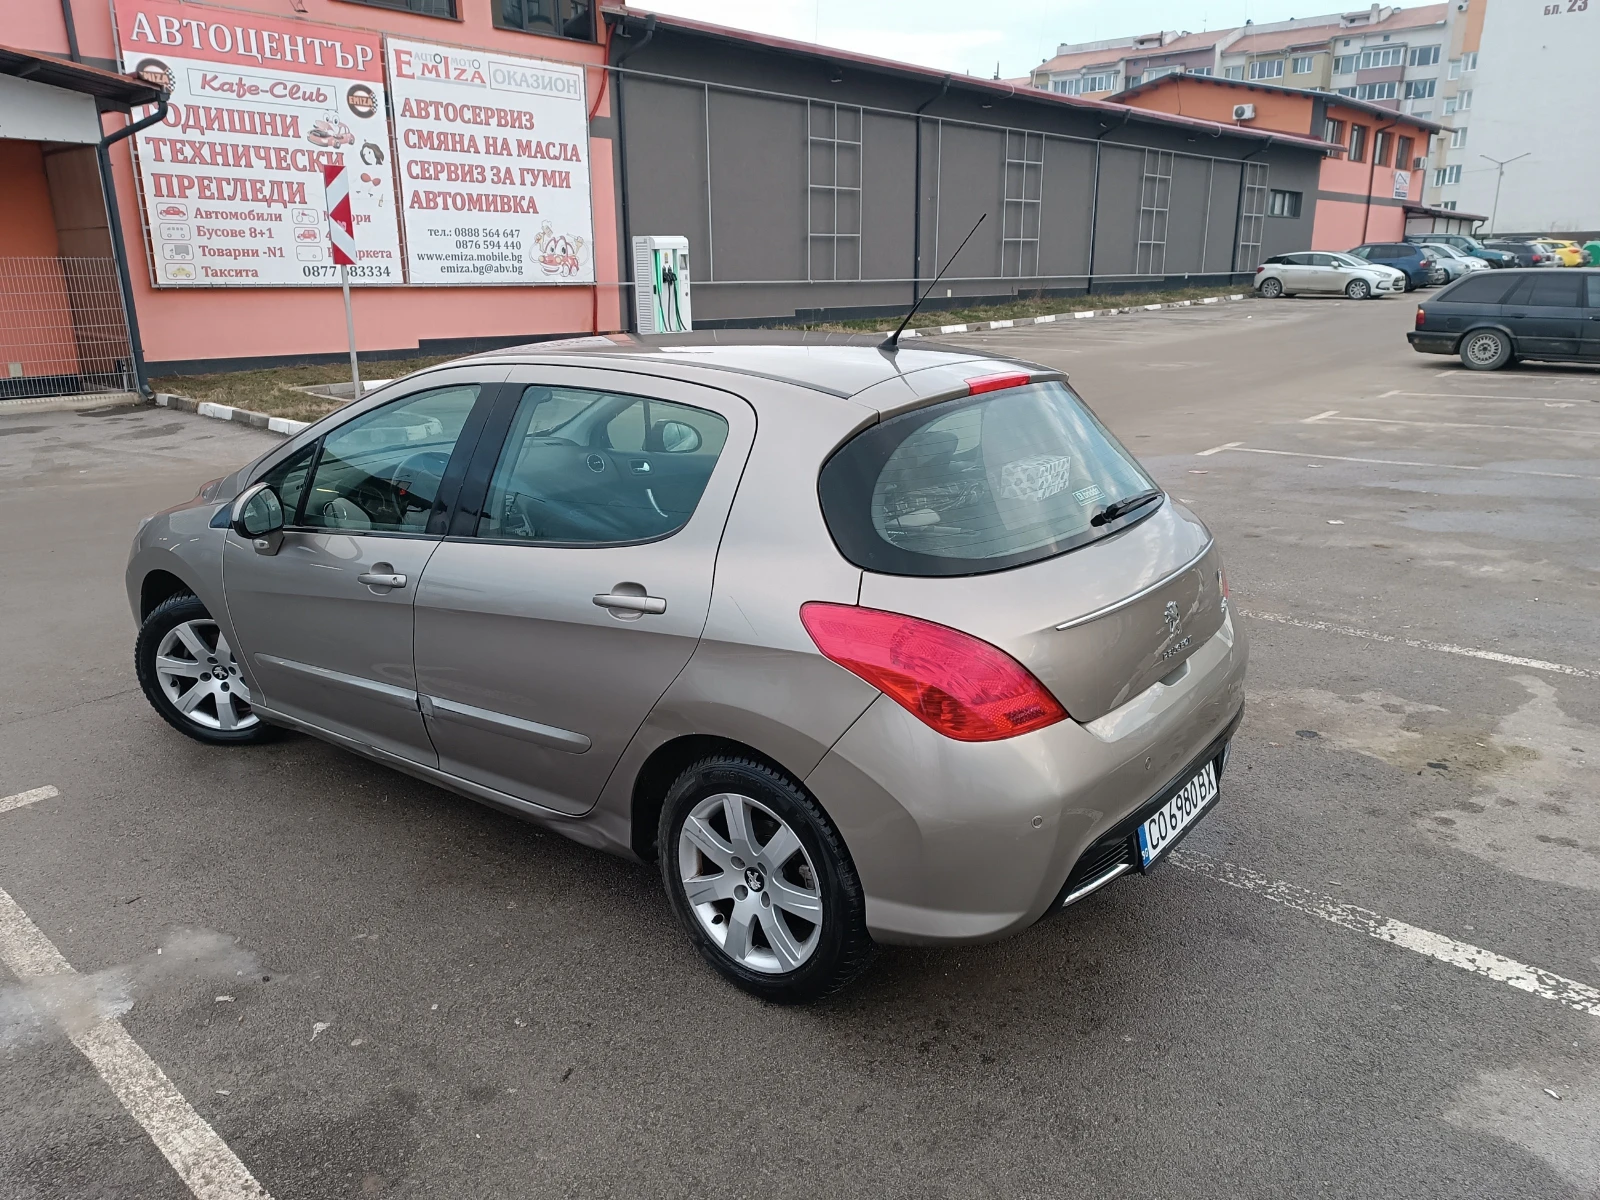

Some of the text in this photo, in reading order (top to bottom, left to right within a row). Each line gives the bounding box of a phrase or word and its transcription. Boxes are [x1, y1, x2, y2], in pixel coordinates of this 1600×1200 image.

[1566, 0, 1589, 13] 23
[130, 12, 374, 72] АВТОЦЕНТЪР
[140, 71, 170, 86] MIZA
[492, 68, 579, 95] ОКАЗИОН
[200, 73, 328, 104] Kafe-Club
[348, 95, 374, 108] EMIZA
[401, 97, 535, 131] АВТОСЕРВИЗ
[403, 128, 581, 162] СМЯНА НА МАСЛА
[406, 160, 571, 189] СЕРВИЗ ЗА ГУМИ
[151, 173, 307, 208] ПРЕГЛЕДИ
[409, 190, 539, 214] АВТОМИВКА
[194, 207, 283, 222] Автомобили
[196, 225, 275, 240] Бусове 8+1
[454, 227, 481, 238] 0888
[482, 228, 501, 238] 564
[502, 229, 521, 239] 647
[198, 245, 260, 260] Товарни
[455, 239, 522, 251] 0876 594 440
[417, 251, 523, 264] www.emiza.mobile.bg
[201, 265, 260, 278] Таксита
[302, 265, 392, 278] 0877 83334
[440, 264, 524, 276] emiza.bg@abv.bg
